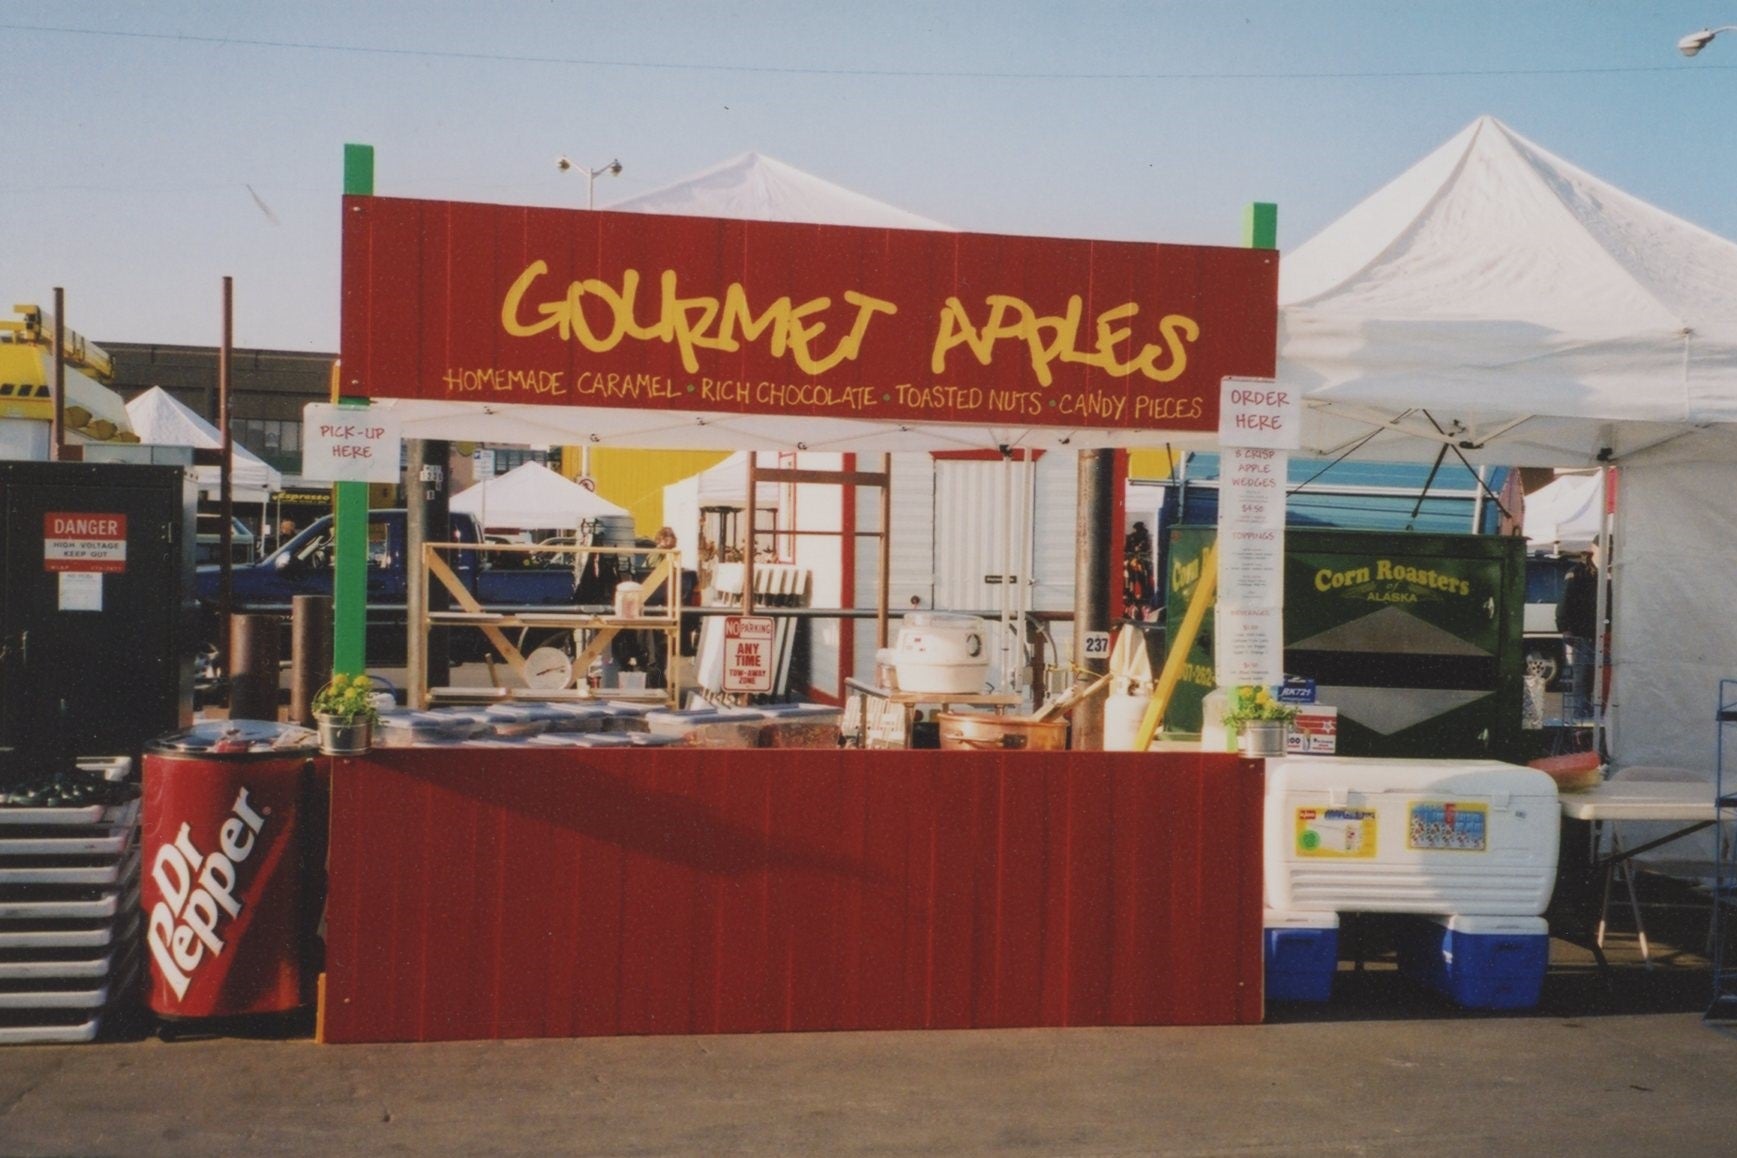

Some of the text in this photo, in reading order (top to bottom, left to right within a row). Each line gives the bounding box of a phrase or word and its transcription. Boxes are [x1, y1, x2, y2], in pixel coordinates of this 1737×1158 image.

[502, 260, 1200, 387] GOURMET APPLES
[443, 367, 1204, 421] HOMEMADE CARAMEL RICH CHOCOLATE TOASTED NUTS CANDY PIECES
[1231, 389, 1290, 407] ORDER
[1236, 413, 1282, 431] HERE
[320, 425, 385, 440] PICK-UP
[332, 445, 372, 459] HERE
[1245, 449, 1276, 460] CRISP
[1238, 463, 1271, 474] APPLE
[1231, 478, 1277, 488] WEDGES
[54, 519, 118, 536] DANGER
[53, 541, 120, 550] HIGH VOLTAGE
[1314, 559, 1470, 597] Corn Roasters
[1366, 591, 1418, 604] ALASKA
[727, 620, 771, 637] NO PARKING
[737, 642, 760, 655] ANY
[1086, 637, 1108, 652] 237
[735, 655, 761, 667] TIME
[729, 669, 766, 677] TOW-AWAY
[151, 820, 205, 918] Dr
[147, 785, 266, 1003] Pepper
